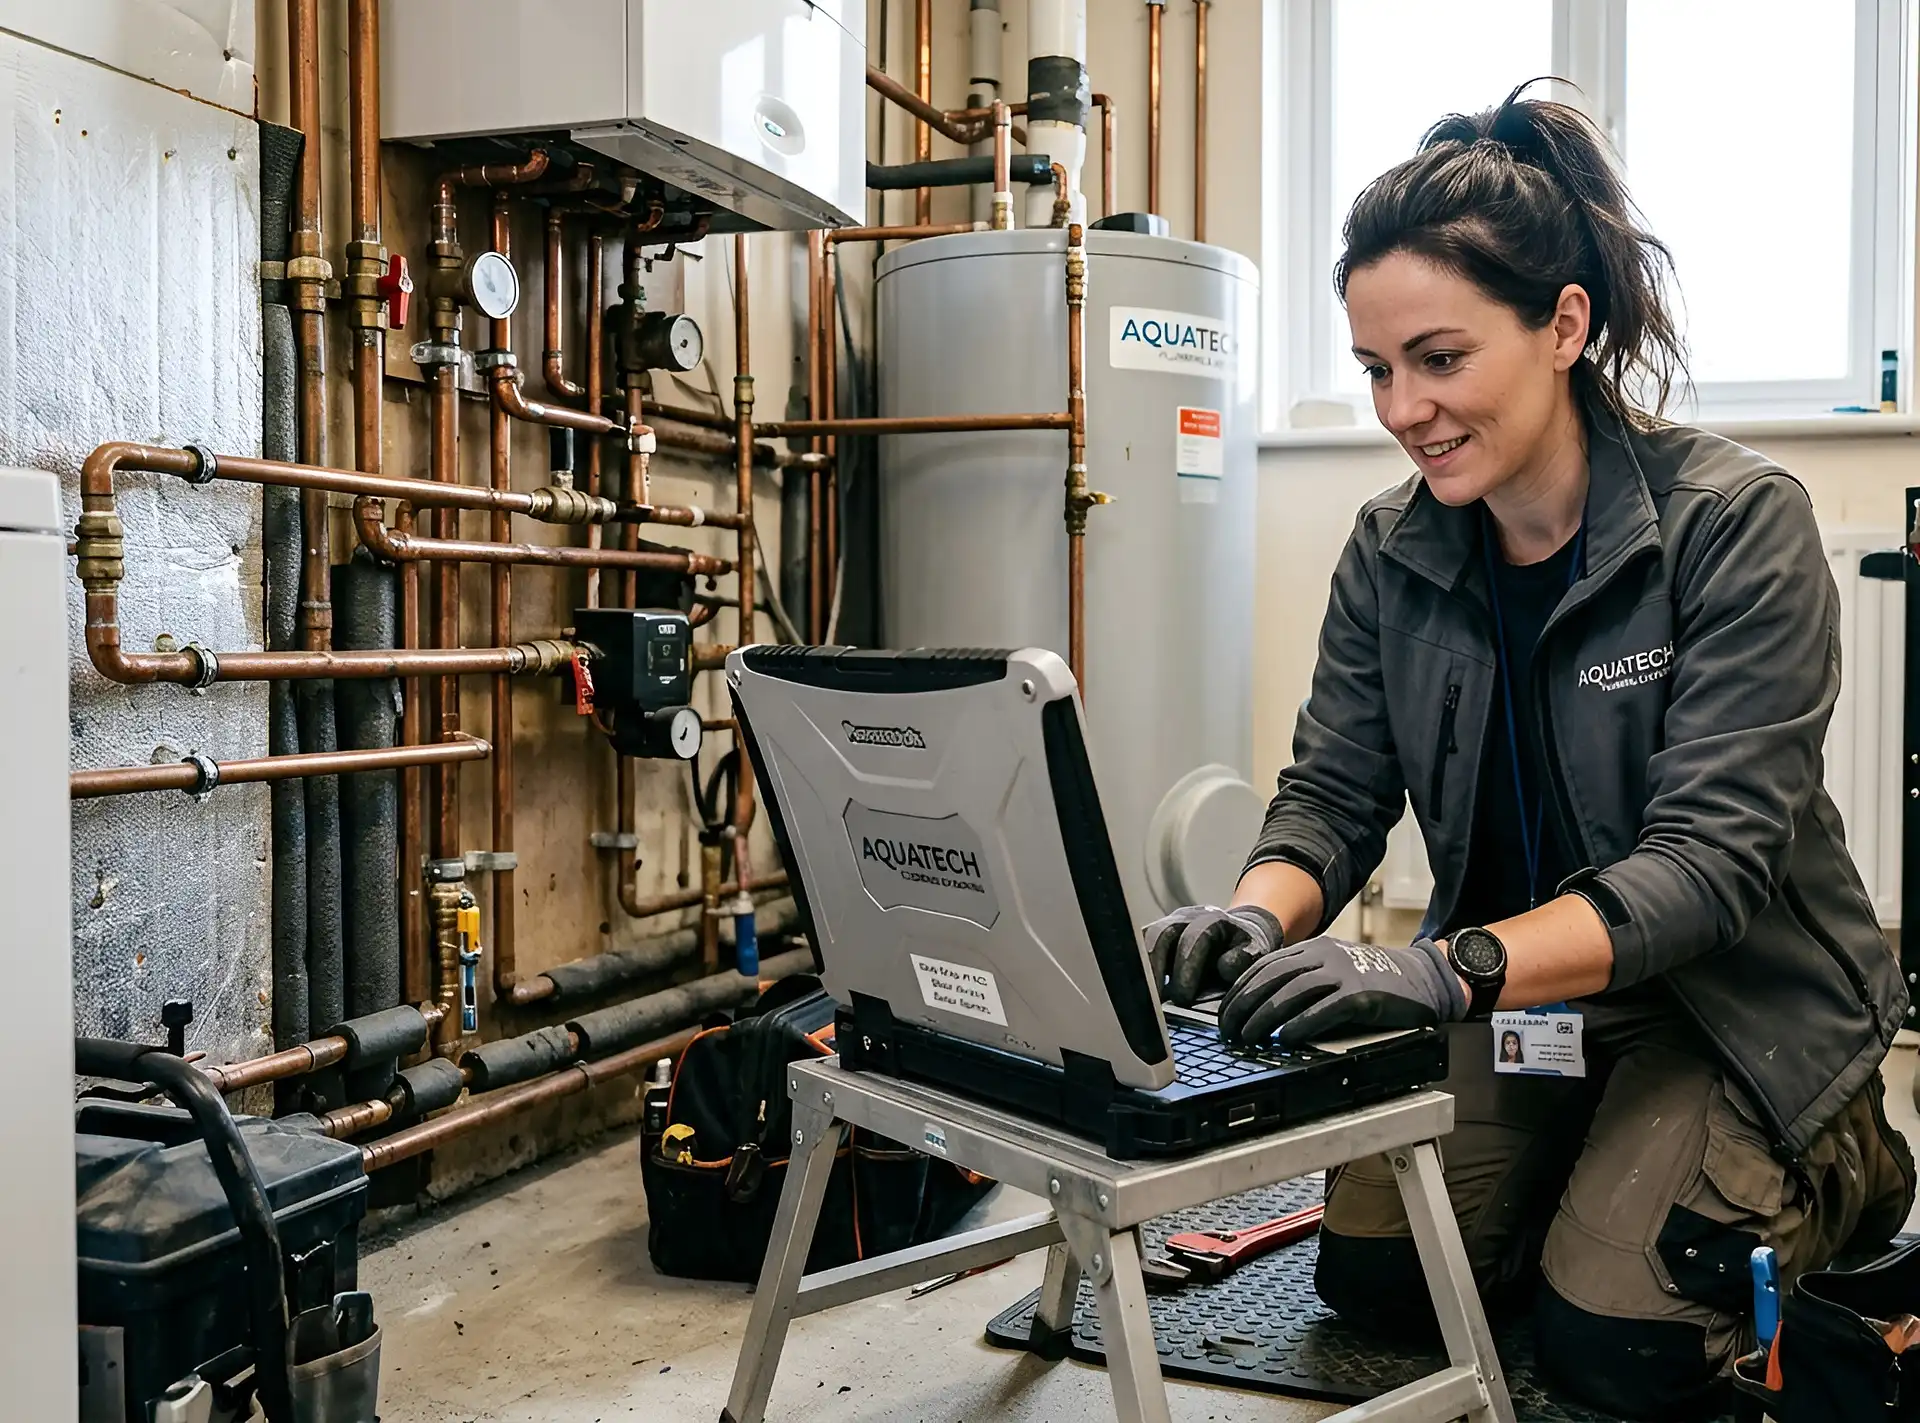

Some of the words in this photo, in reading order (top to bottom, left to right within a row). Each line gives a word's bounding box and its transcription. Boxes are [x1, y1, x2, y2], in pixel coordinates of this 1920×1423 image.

[1121, 318, 1239, 355] AQUATEC
[1578, 640, 1675, 687] AQUATECH
[863, 836, 981, 878] AQUATECH
